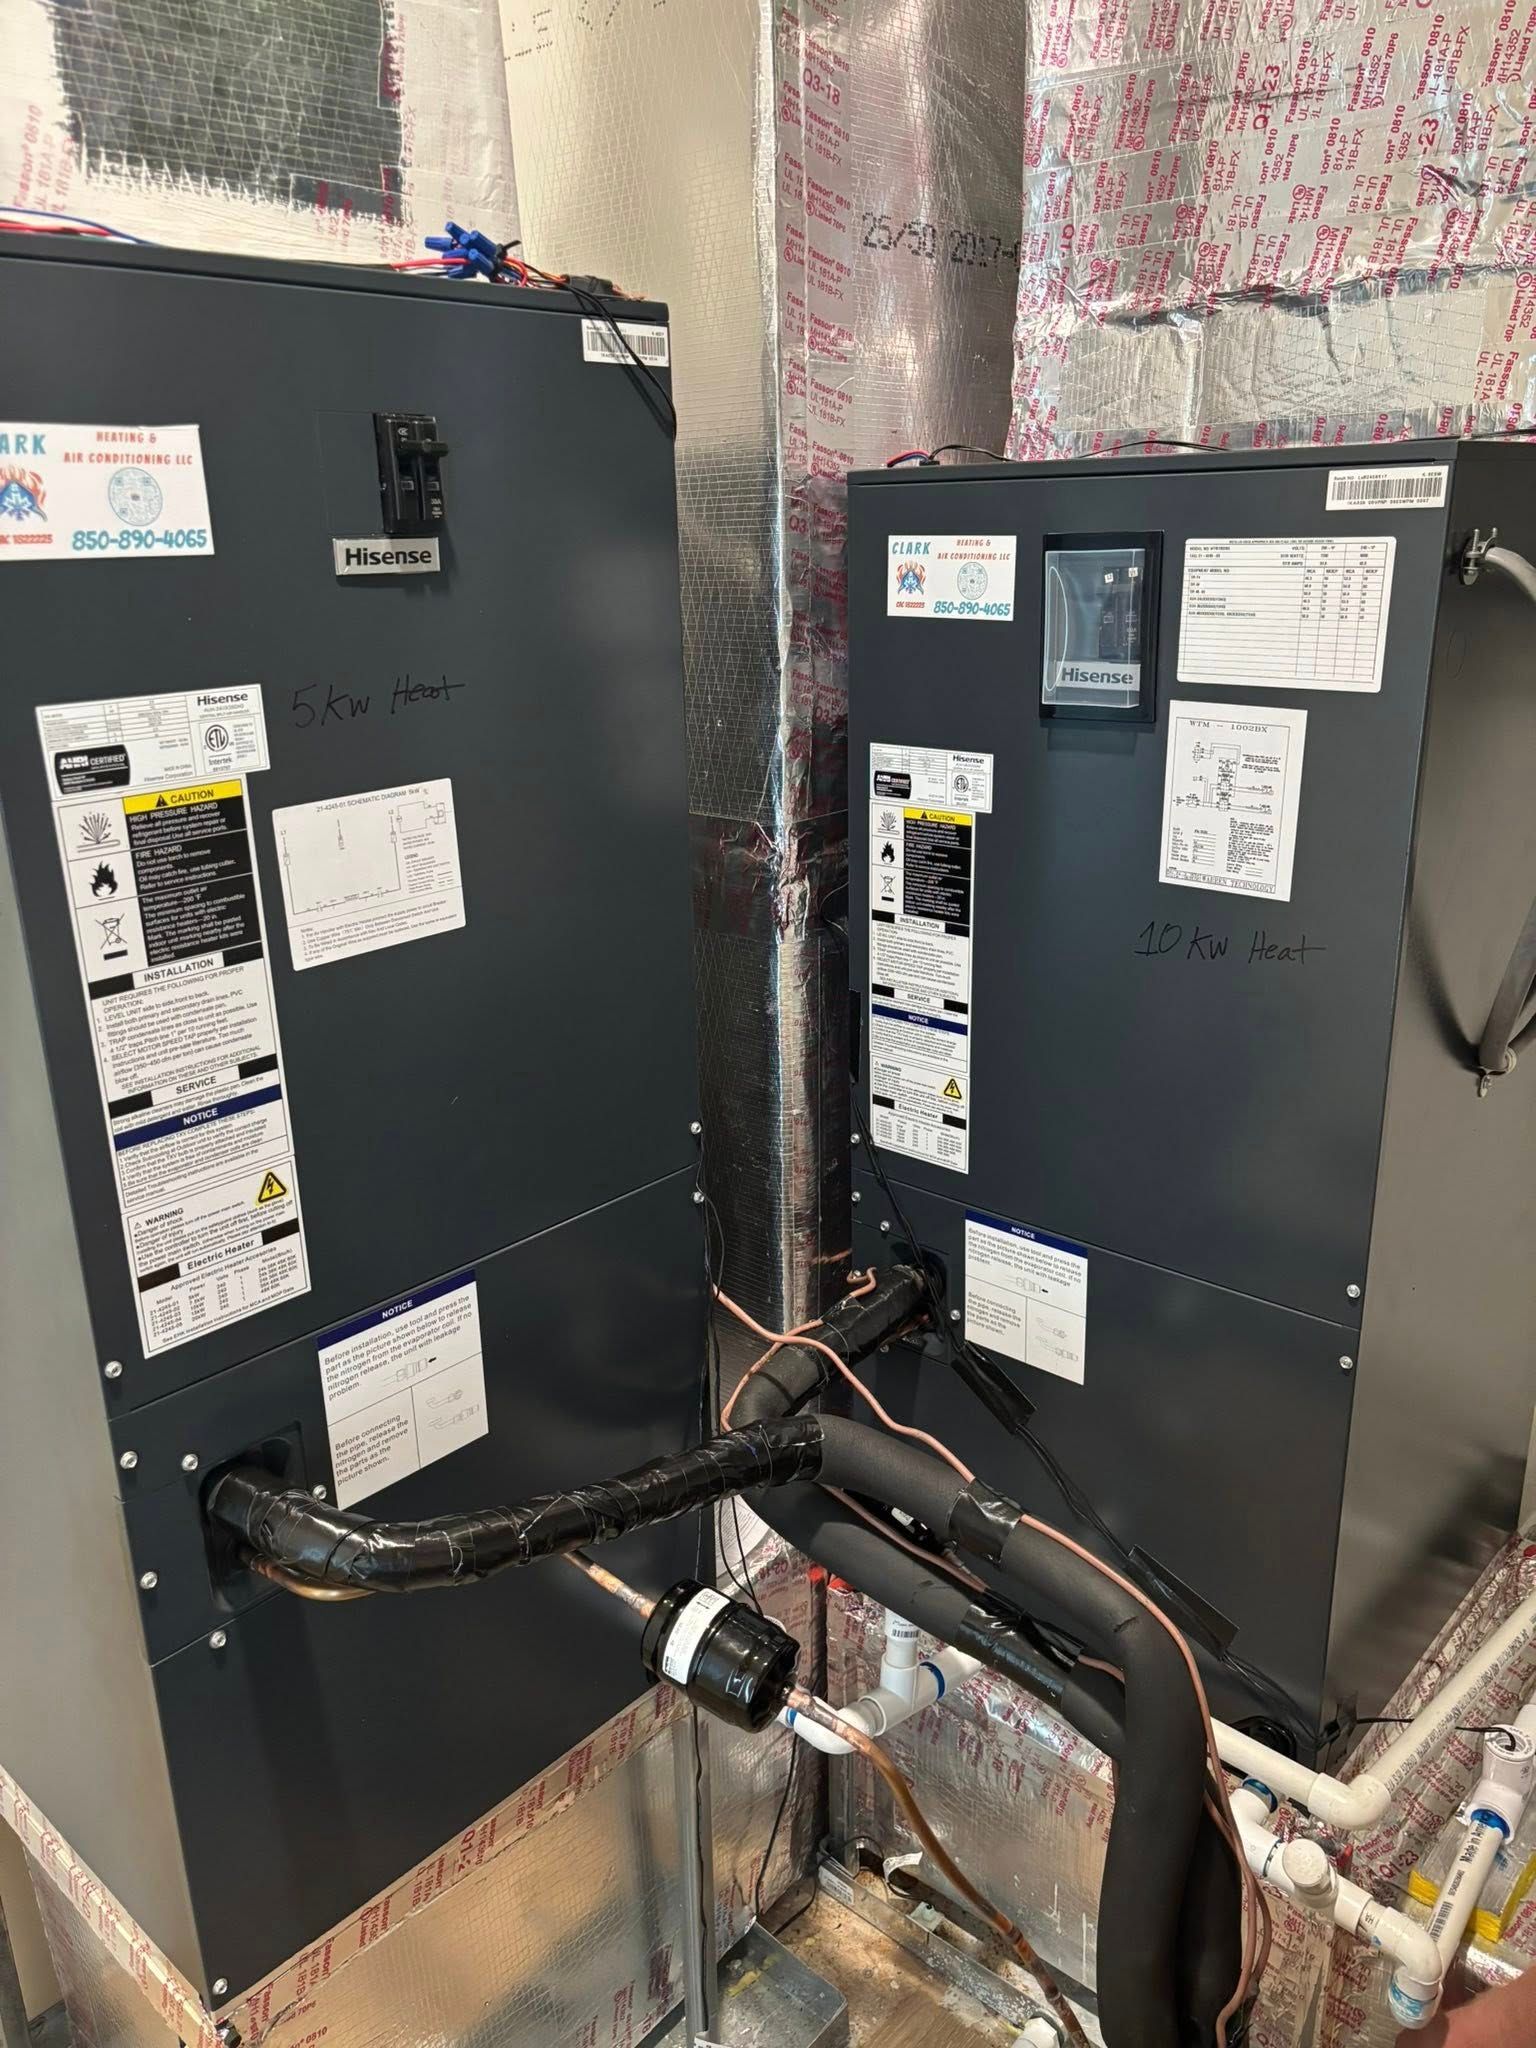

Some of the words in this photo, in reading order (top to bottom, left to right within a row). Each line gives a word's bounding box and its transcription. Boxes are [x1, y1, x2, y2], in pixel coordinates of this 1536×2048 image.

[803, 68, 840, 105] Q3-18
[96, 432, 144, 443] HEATING
[149, 433, 156, 443] &
[64, 453, 84, 463] AIR
[89, 453, 171, 464] CONDITIONING
[177, 454, 193, 465] LLC
[72, 529, 207, 551] 850-890-4065
[892, 542, 931, 554] CLARK
[346, 548, 432, 566] Hisense
[933, 601, 1011, 616] 850-890-4065
[1062, 667, 1133, 684] Hisense
[196, 691, 248, 706] Hisense
[391, 674, 465, 714] Heat
[208, 756, 232, 766] Intertek
[953, 754, 984, 764] Hisense
[170, 788, 214, 804] CAUTION
[347, 795, 380, 806] SCHEMATIC
[381, 790, 406, 800] DIAGRAM
[129, 813, 147, 823] HIGH
[150, 807, 187, 819] PRESSURE
[190, 802, 218, 813] HAZARD
[929, 813, 955, 822] CAUTION
[135, 850, 151, 859] FIRE
[153, 844, 182, 856] HAZARD
[900, 917, 939, 929] INSTALLATION
[1248, 930, 1327, 964] Heat
[143, 958, 214, 982] INSTALLATION
[101, 997, 116, 1007] UNIT
[907, 993, 930, 1003] SERVICE
[908, 1014, 928, 1024] NOTICE
[175, 1075, 216, 1095] SERVICE
[182, 1107, 218, 1125] NOTICE
[898, 1103, 918, 1114] Electric
[920, 1109, 938, 1119] Heater
[145, 1206, 183, 1226] WARNING
[1011, 1227, 1035, 1239] NOTICE
[186, 1249, 222, 1271] Electric
[224, 1237, 254, 1256] Heater
[382, 1300, 413, 1319] NOTICE
[324, 1347, 349, 1364] Before
[395, 1323, 408, 1333] use
[409, 1315, 422, 1326] tool
[423, 1308, 436, 1320] and
[438, 1301, 457, 1315] press
[458, 1294, 469, 1304] the
[325, 1361, 341, 1375] part
[342, 1358, 351, 1366] as
[352, 1350, 364, 1361] the
[365, 1338, 391, 1357] picture
[392, 1327, 415, 1343] shown
[416, 1317, 437, 1332] below
[438, 1314, 444, 1322] to
[446, 1302, 471, 1319] release
[326, 1371, 338, 1382] the
[340, 1356, 371, 1377] nitrogen
[372, 1348, 388, 1361] from
[389, 1342, 401, 1353] the
[402, 1324, 440, 1349] evaporator
[463, 1312, 471, 1320] no
[327, 1371, 359, 1392] nitrogen
[390, 1351, 402, 1362] the
[403, 1344, 417, 1356] unit
[418, 1337, 432, 1349] with
[433, 1324, 460, 1343] leakage
[335, 1433, 359, 1450] Before
[361, 1413, 400, 1439] connecting
[336, 1447, 348, 1459] the
[368, 1424, 395, 1443] release
[396, 1418, 408, 1429] the
[335, 1448, 365, 1470] nitrogen
[366, 1440, 380, 1452] and
[381, 1428, 407, 1445] remove
[336, 1465, 347, 1477] the
[349, 1455, 368, 1471] parts
[369, 1452, 377, 1460] as
[379, 1443, 390, 1455] the
[337, 1467, 362, 1487] picture
[1460, 1843, 1480, 1863] Made
[1378, 1851, 1418, 1879] Q1-23
